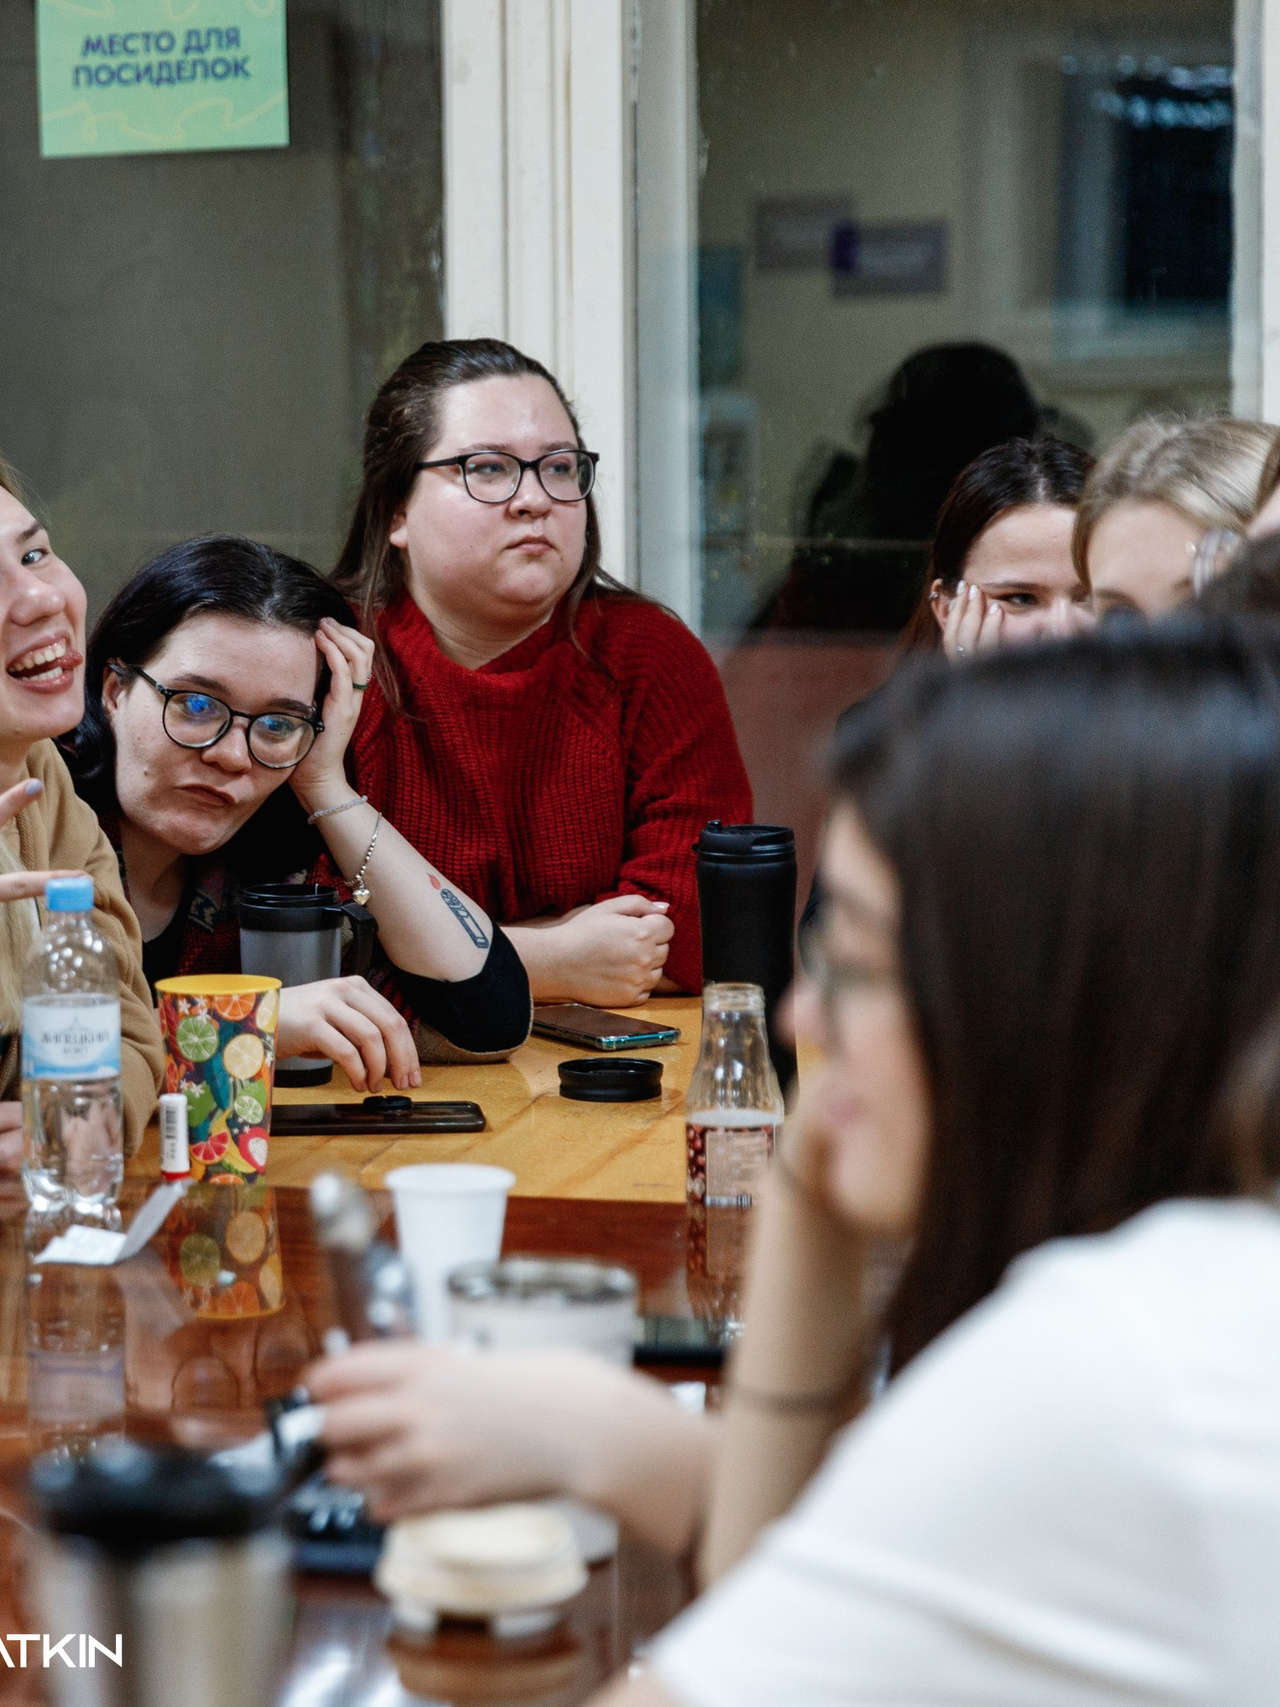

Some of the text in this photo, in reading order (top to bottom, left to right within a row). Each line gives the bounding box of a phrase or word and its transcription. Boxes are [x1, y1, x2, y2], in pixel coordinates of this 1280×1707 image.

[81, 26, 241, 57] МЕСТО ДЛЯ
[73, 56, 251, 88] ПОСИДЕЛОК
